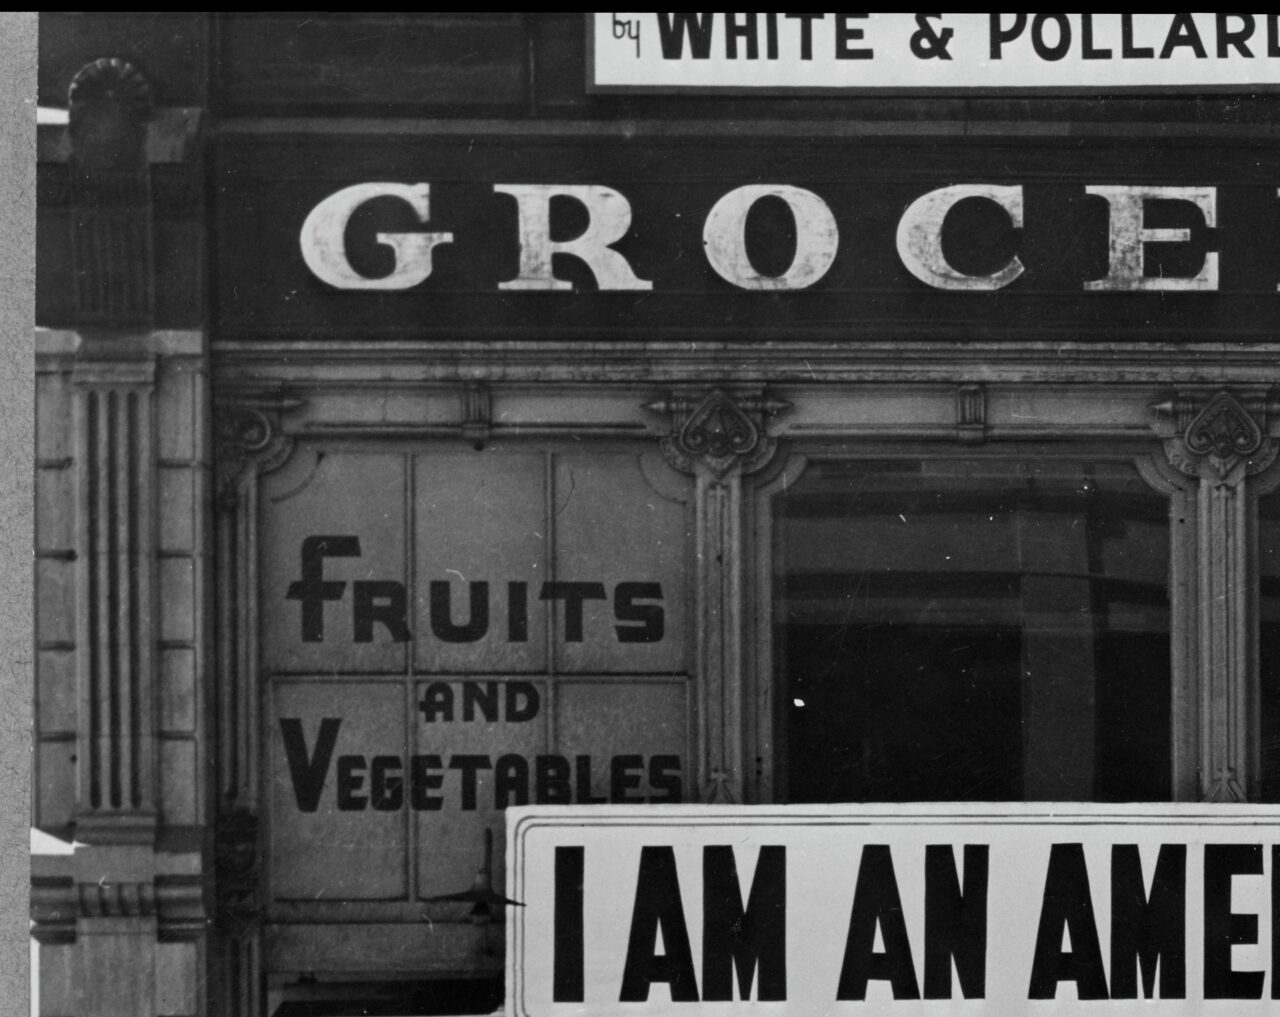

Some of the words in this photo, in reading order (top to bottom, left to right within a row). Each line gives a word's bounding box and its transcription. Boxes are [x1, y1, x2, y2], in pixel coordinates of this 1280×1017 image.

[612, 13, 640, 58] by
[657, 13, 874, 60] WHITE
[909, 13, 954, 60] &
[418, 680, 541, 723] AND
[552, 845, 586, 1003] I
[618, 844, 787, 1003] AM
[836, 843, 990, 1001] AN
